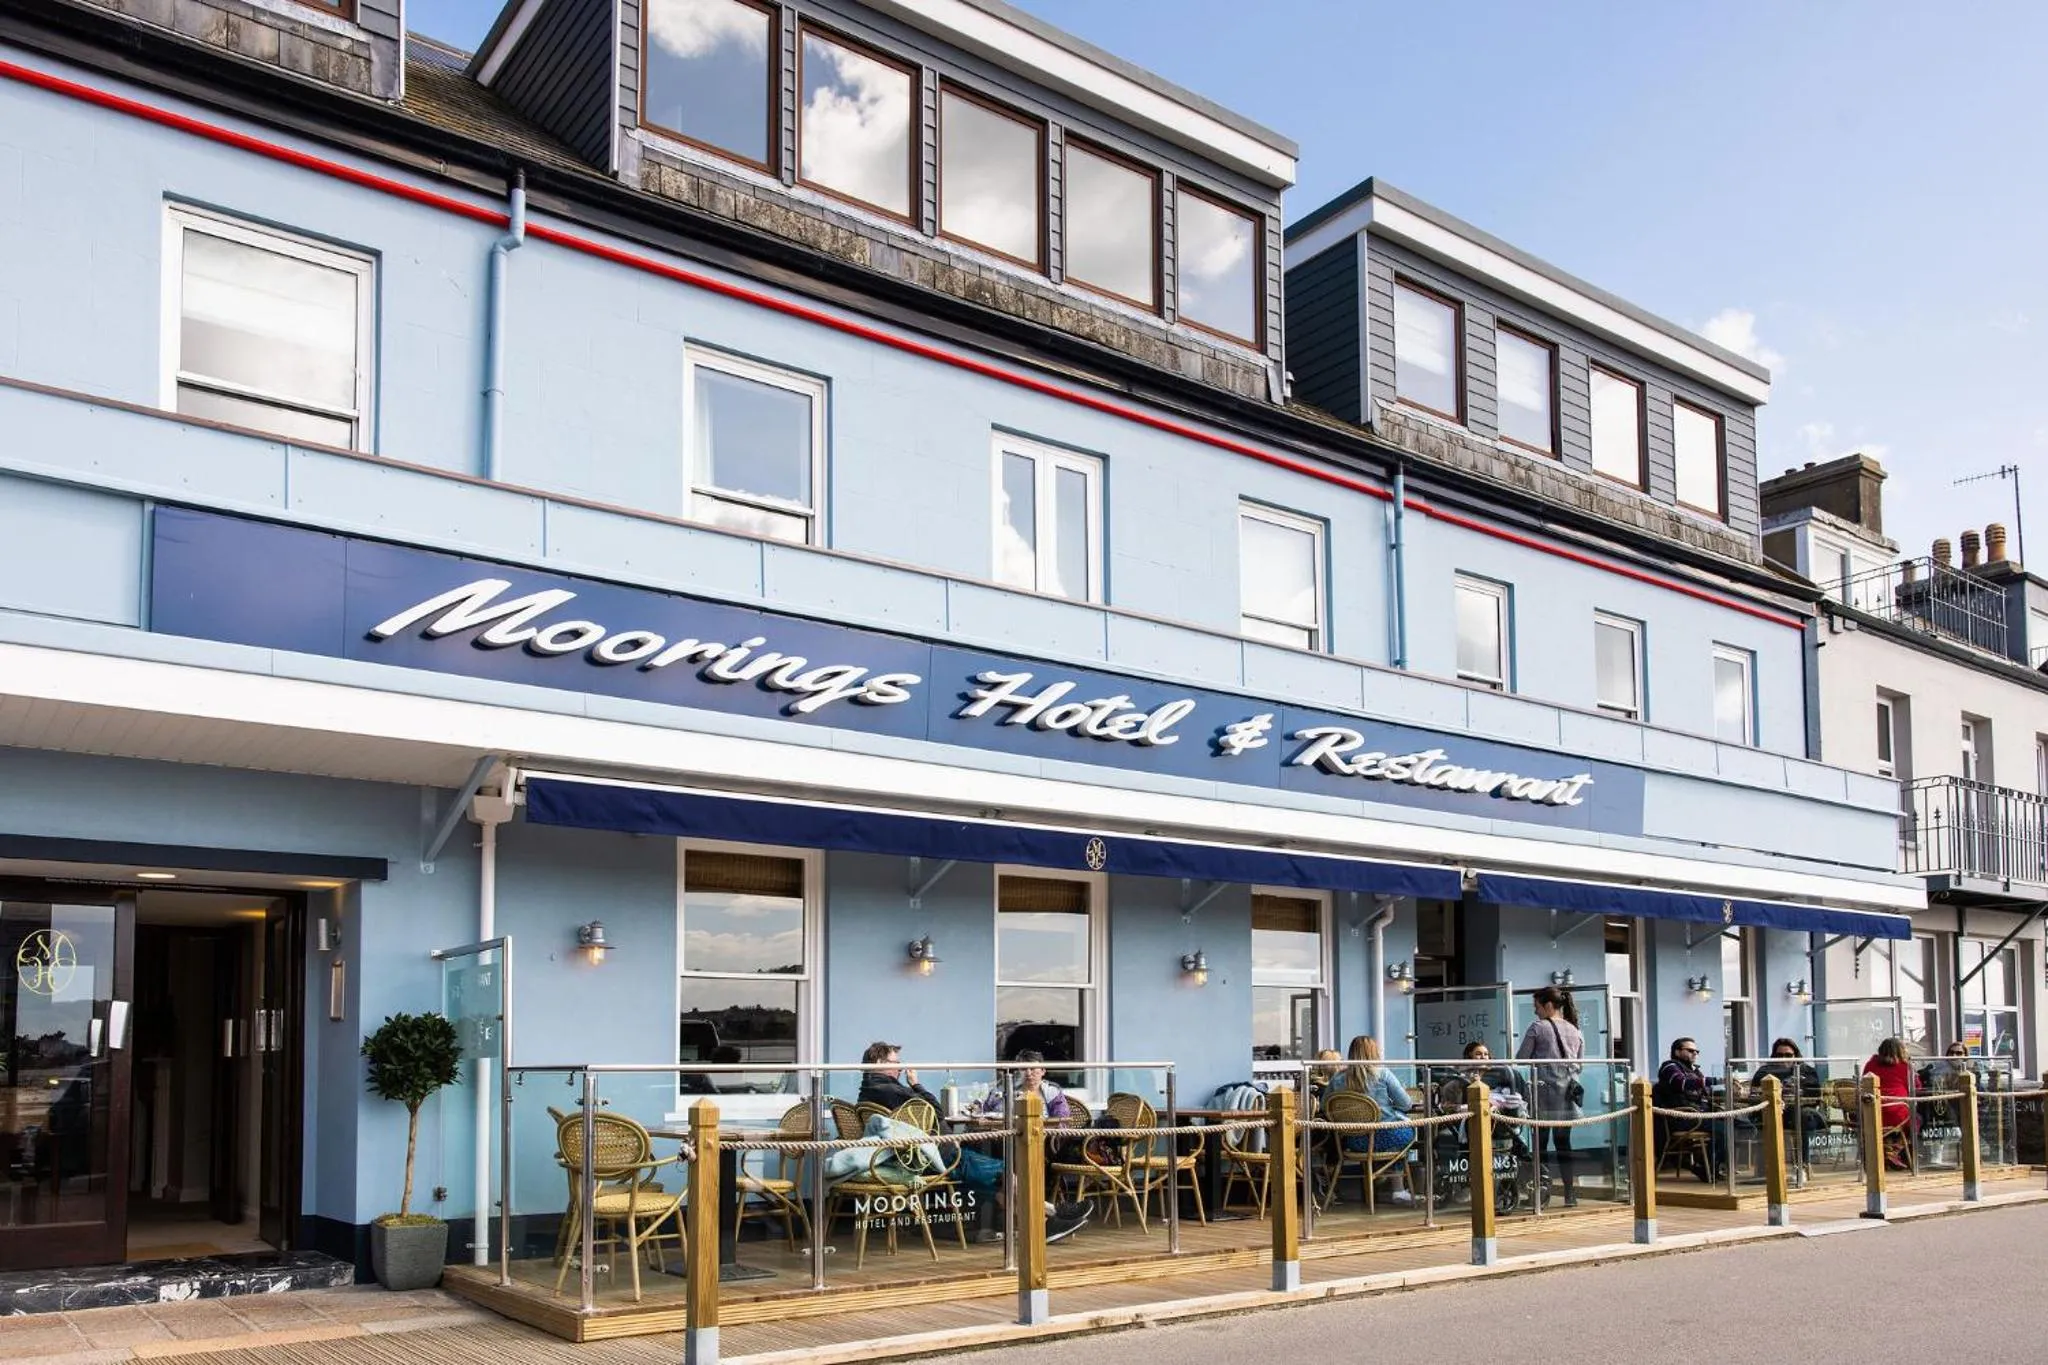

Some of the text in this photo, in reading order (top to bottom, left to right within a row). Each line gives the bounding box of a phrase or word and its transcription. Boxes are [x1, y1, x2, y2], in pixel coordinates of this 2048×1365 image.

[368, 578, 1594, 807] Moorings Hotel & Restaurant
[1808, 1133, 1852, 1147] MOORINGS
[1449, 1154, 1518, 1173] MONGS
[855, 1190, 976, 1215] MOORINGS
[855, 1211, 977, 1230] HOTEL AND RESTAURANT
